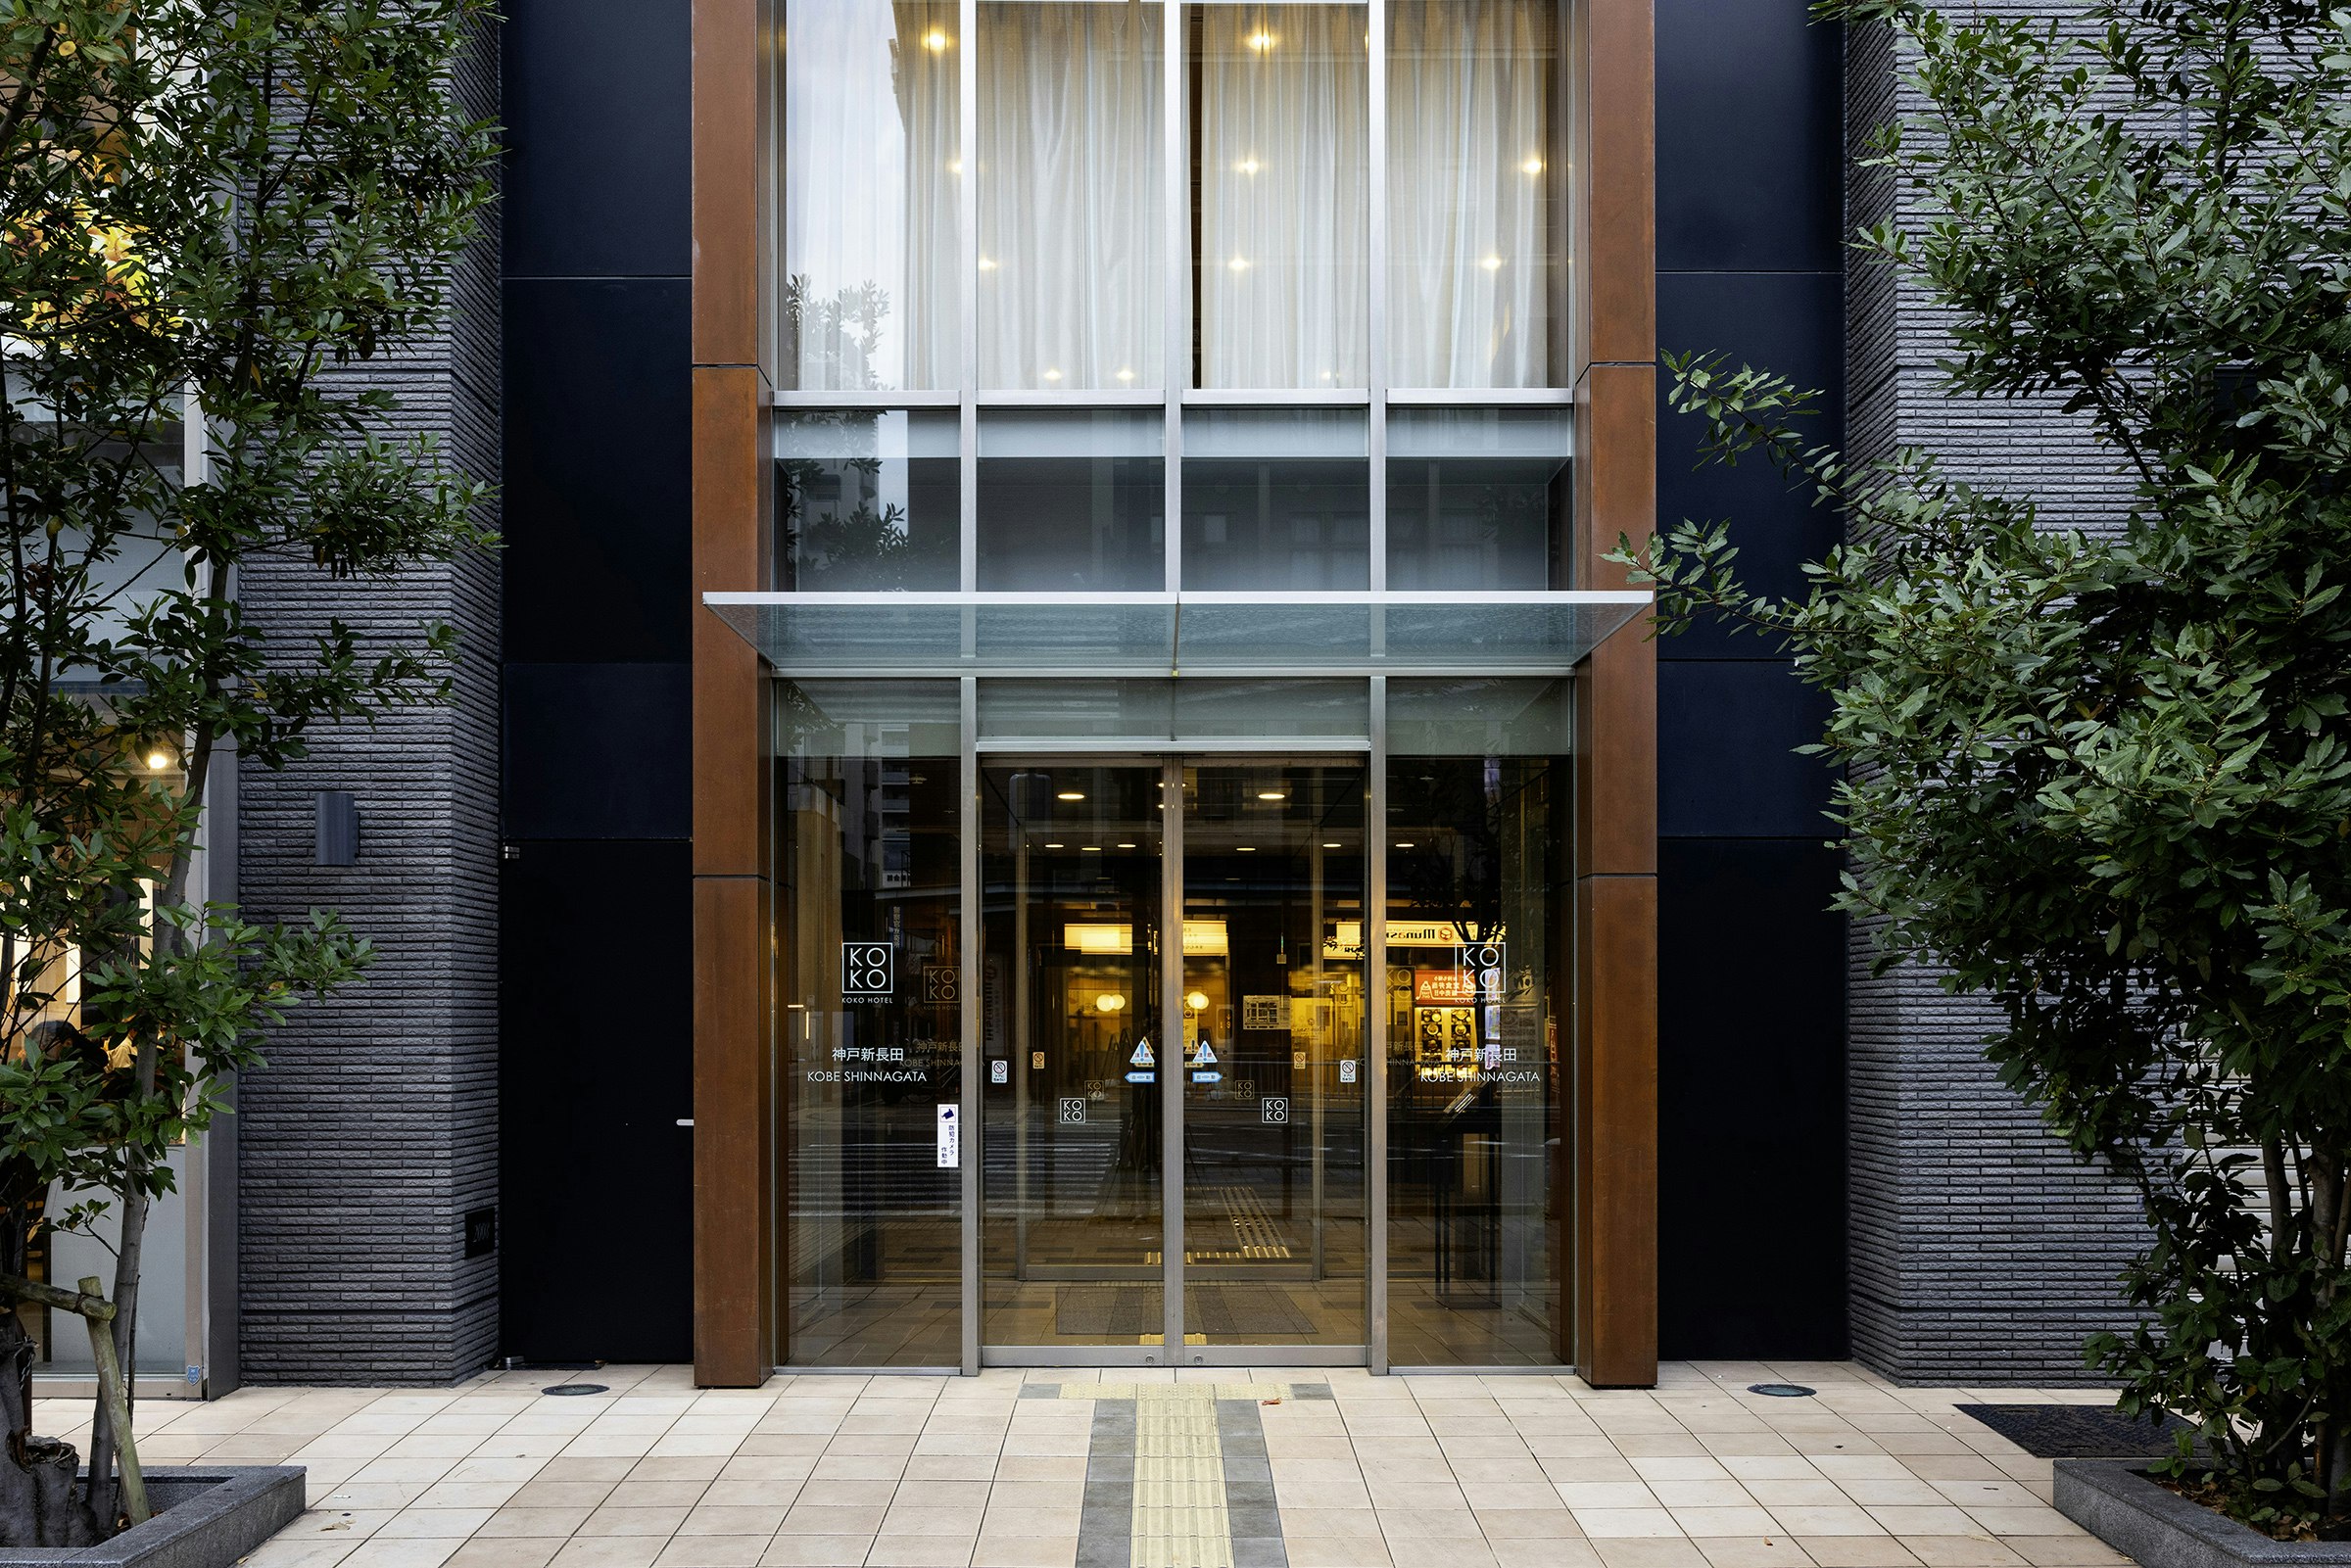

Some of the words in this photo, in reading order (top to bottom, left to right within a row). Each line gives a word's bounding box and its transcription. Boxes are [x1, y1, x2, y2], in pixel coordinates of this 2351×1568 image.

[850, 947, 886, 967] KO
[1463, 947, 1499, 967] KO
[850, 969, 886, 988] KO
[832, 1047, 904, 1062] 神戸新長田
[1445, 1047, 1517, 1063] 神戸新長田
[899, 1059, 923, 1068] KOBE
[926, 1059, 962, 1068] SHINNA
[807, 1071, 840, 1082] KOBE
[843, 1071, 927, 1082] SHINNAGATA
[1420, 1071, 1454, 1082] KOBE
[1457, 1071, 1540, 1082] SHINNAGATA
[1064, 1100, 1082, 1111] KO
[1266, 1100, 1285, 1111] KO
[1064, 1111, 1082, 1121] KO
[1266, 1111, 1285, 1121] KO
